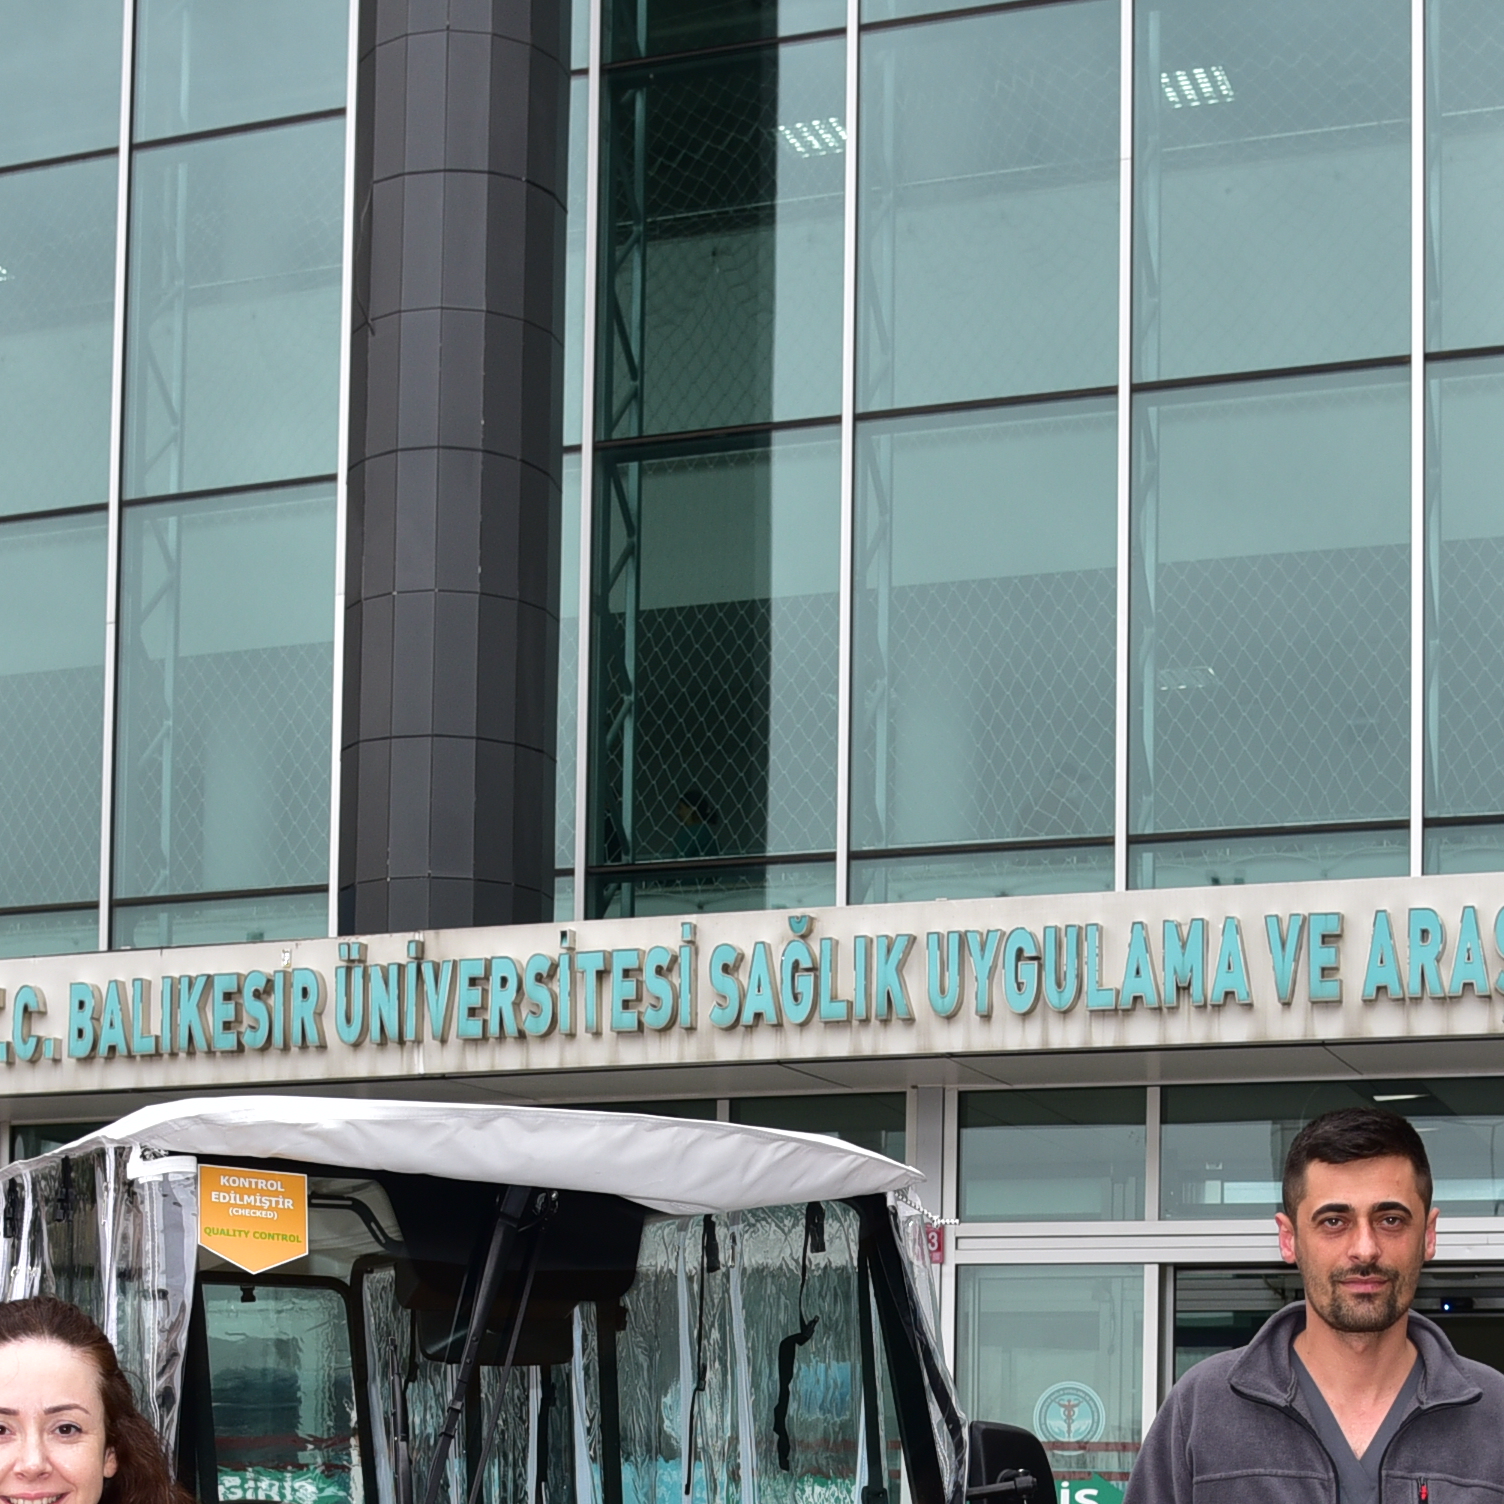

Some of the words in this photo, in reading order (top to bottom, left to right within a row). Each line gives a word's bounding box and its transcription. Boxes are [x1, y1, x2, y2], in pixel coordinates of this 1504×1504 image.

[66, 947, 326, 1060] BALIKESİR
[334, 922, 697, 1045] ÜNİVERSİTESİ
[708, 914, 916, 1028] SAĞLIK
[926, 916, 1253, 1018] UYGULAMA
[1265, 912, 1344, 1003] VE
[220, 1175, 285, 1192] KONTROL
[211, 1191, 294, 1209] EDİLMİŞTİR
[229, 1207, 278, 1220] (CHECKED)
[203, 1226, 250, 1238] QUALITY
[252, 1231, 303, 1244] CONTROL
